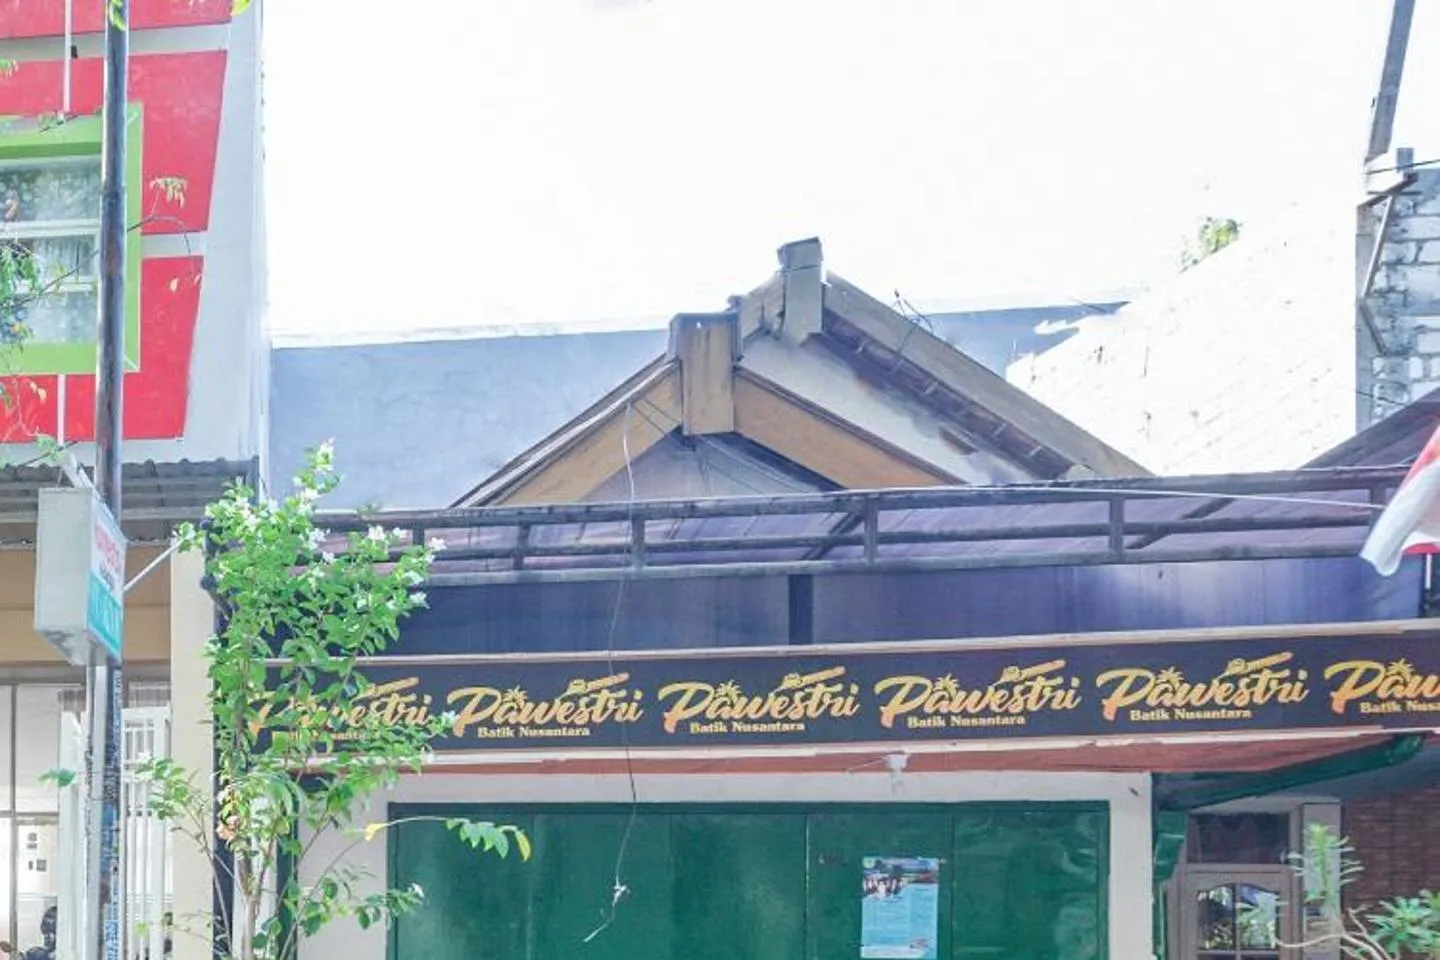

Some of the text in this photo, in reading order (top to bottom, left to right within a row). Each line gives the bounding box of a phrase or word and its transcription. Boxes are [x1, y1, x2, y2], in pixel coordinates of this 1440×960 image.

[1096, 651, 1310, 722] Pawestri
[658, 666, 860, 733] Pawestri
[874, 660, 1083, 729] Pawestri
[447, 672, 644, 738] Pawestri
[1360, 699, 1401, 713] Batik
[907, 715, 1027, 729] Batik Nusantara
[1130, 708, 1252, 722] Batik Nusantara
[477, 726, 591, 739] Batik Nusantara
[690, 721, 805, 734] Batik Nusantara
